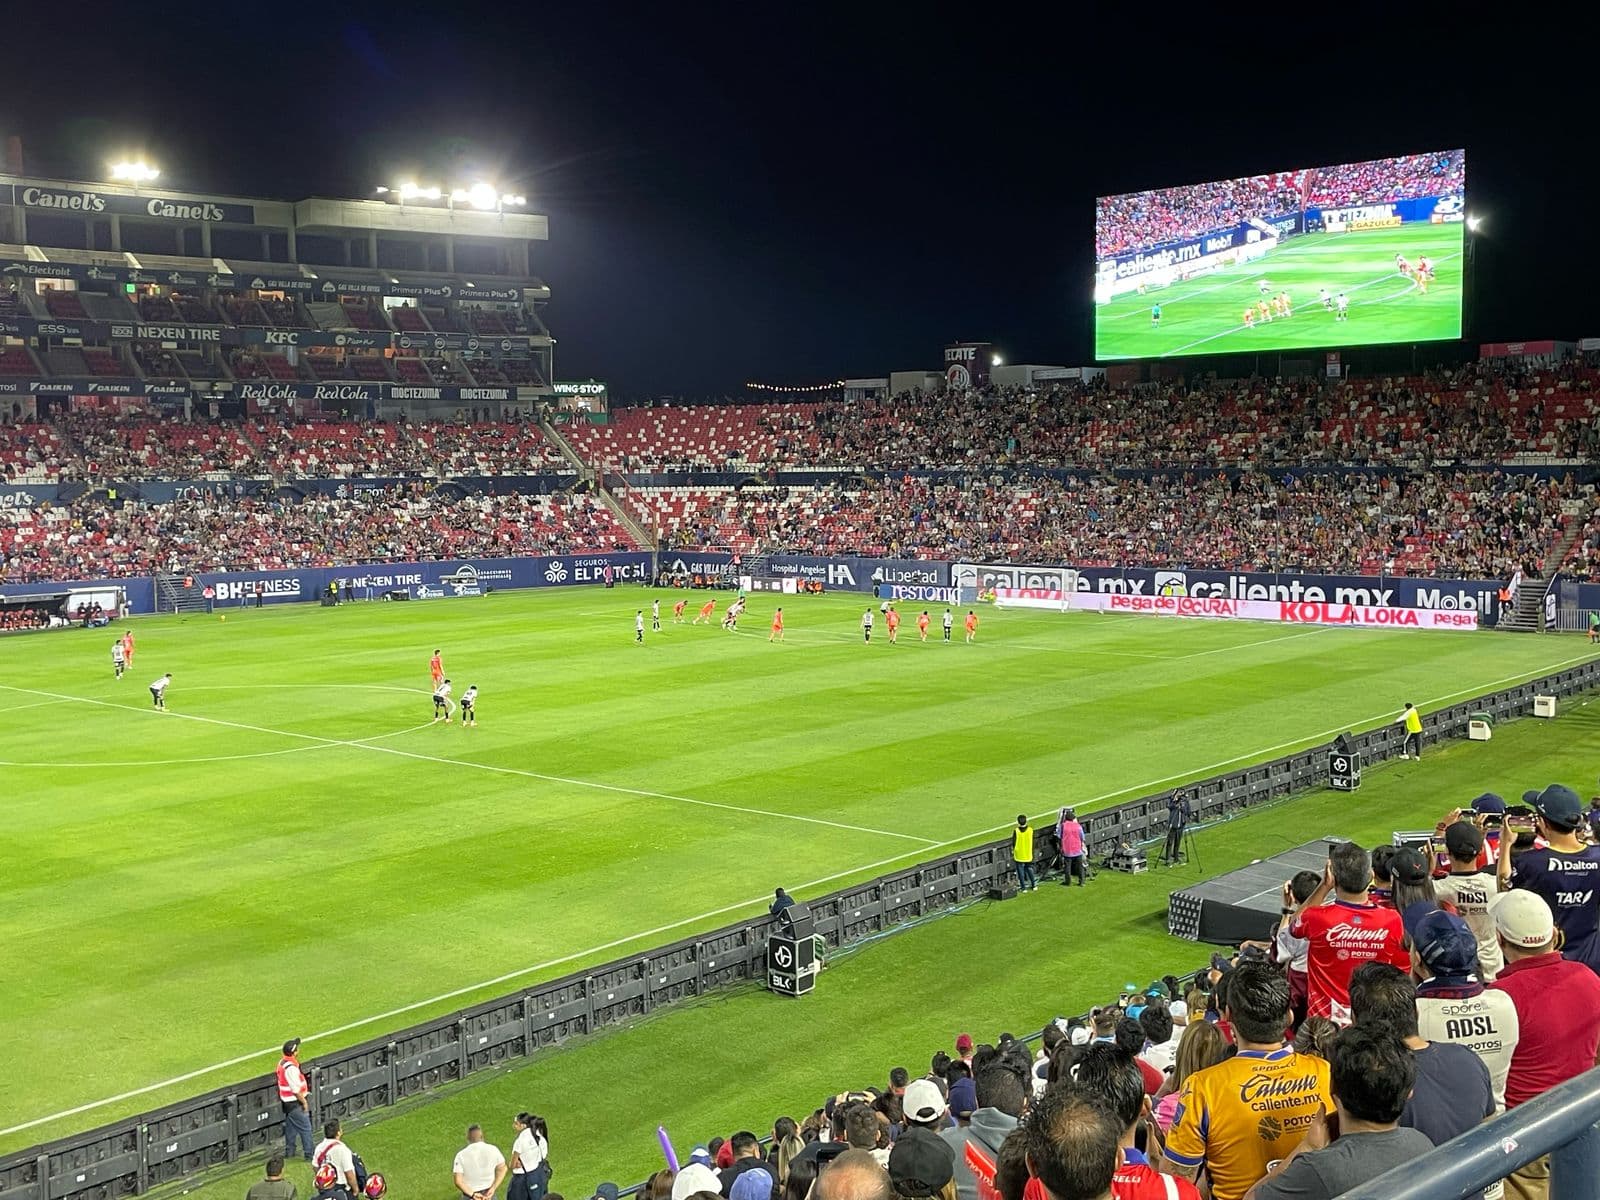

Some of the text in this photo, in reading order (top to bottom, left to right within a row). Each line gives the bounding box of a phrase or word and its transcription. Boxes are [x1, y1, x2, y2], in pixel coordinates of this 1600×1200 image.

[23, 187, 105, 211] Canel's
[147, 199, 224, 221] Canel's
[391, 286, 441, 295] Primera Plus
[460, 289, 508, 298] Primera Plus
[137, 327, 185, 340] NEXEN
[189, 328, 220, 341] TIRE
[265, 331, 298, 344] KFC
[153, 385, 185, 393] DAIKIN
[391, 387, 441, 399] MOCTEZUMA
[460, 388, 509, 400] MOCTEZUMA
[574, 559, 607, 567] SEGUROS
[691, 563, 702, 573] GAS
[772, 563, 826, 575] Hospital Angeles
[395, 573, 422, 585] TIRE
[575, 568, 591, 581] EL
[216, 581, 242, 600] BH
[1416, 588, 1491, 615] Mobil
[1280, 601, 1471, 626] KOLA LOKA pega
[1563, 860, 1598, 871] Dalton
[1457, 891, 1488, 904] ADSL
[1556, 891, 1583, 904] TAR
[1325, 922, 1390, 942] Caliente
[1329, 940, 1385, 949] caliente.mx
[773, 975, 791, 989] BLK
[1446, 1016, 1498, 1039] ADSL
[1239, 1073, 1317, 1103] Caliente
[1251, 1093, 1322, 1112] caliente.mx
[1283, 1113, 1316, 1127] POTO
